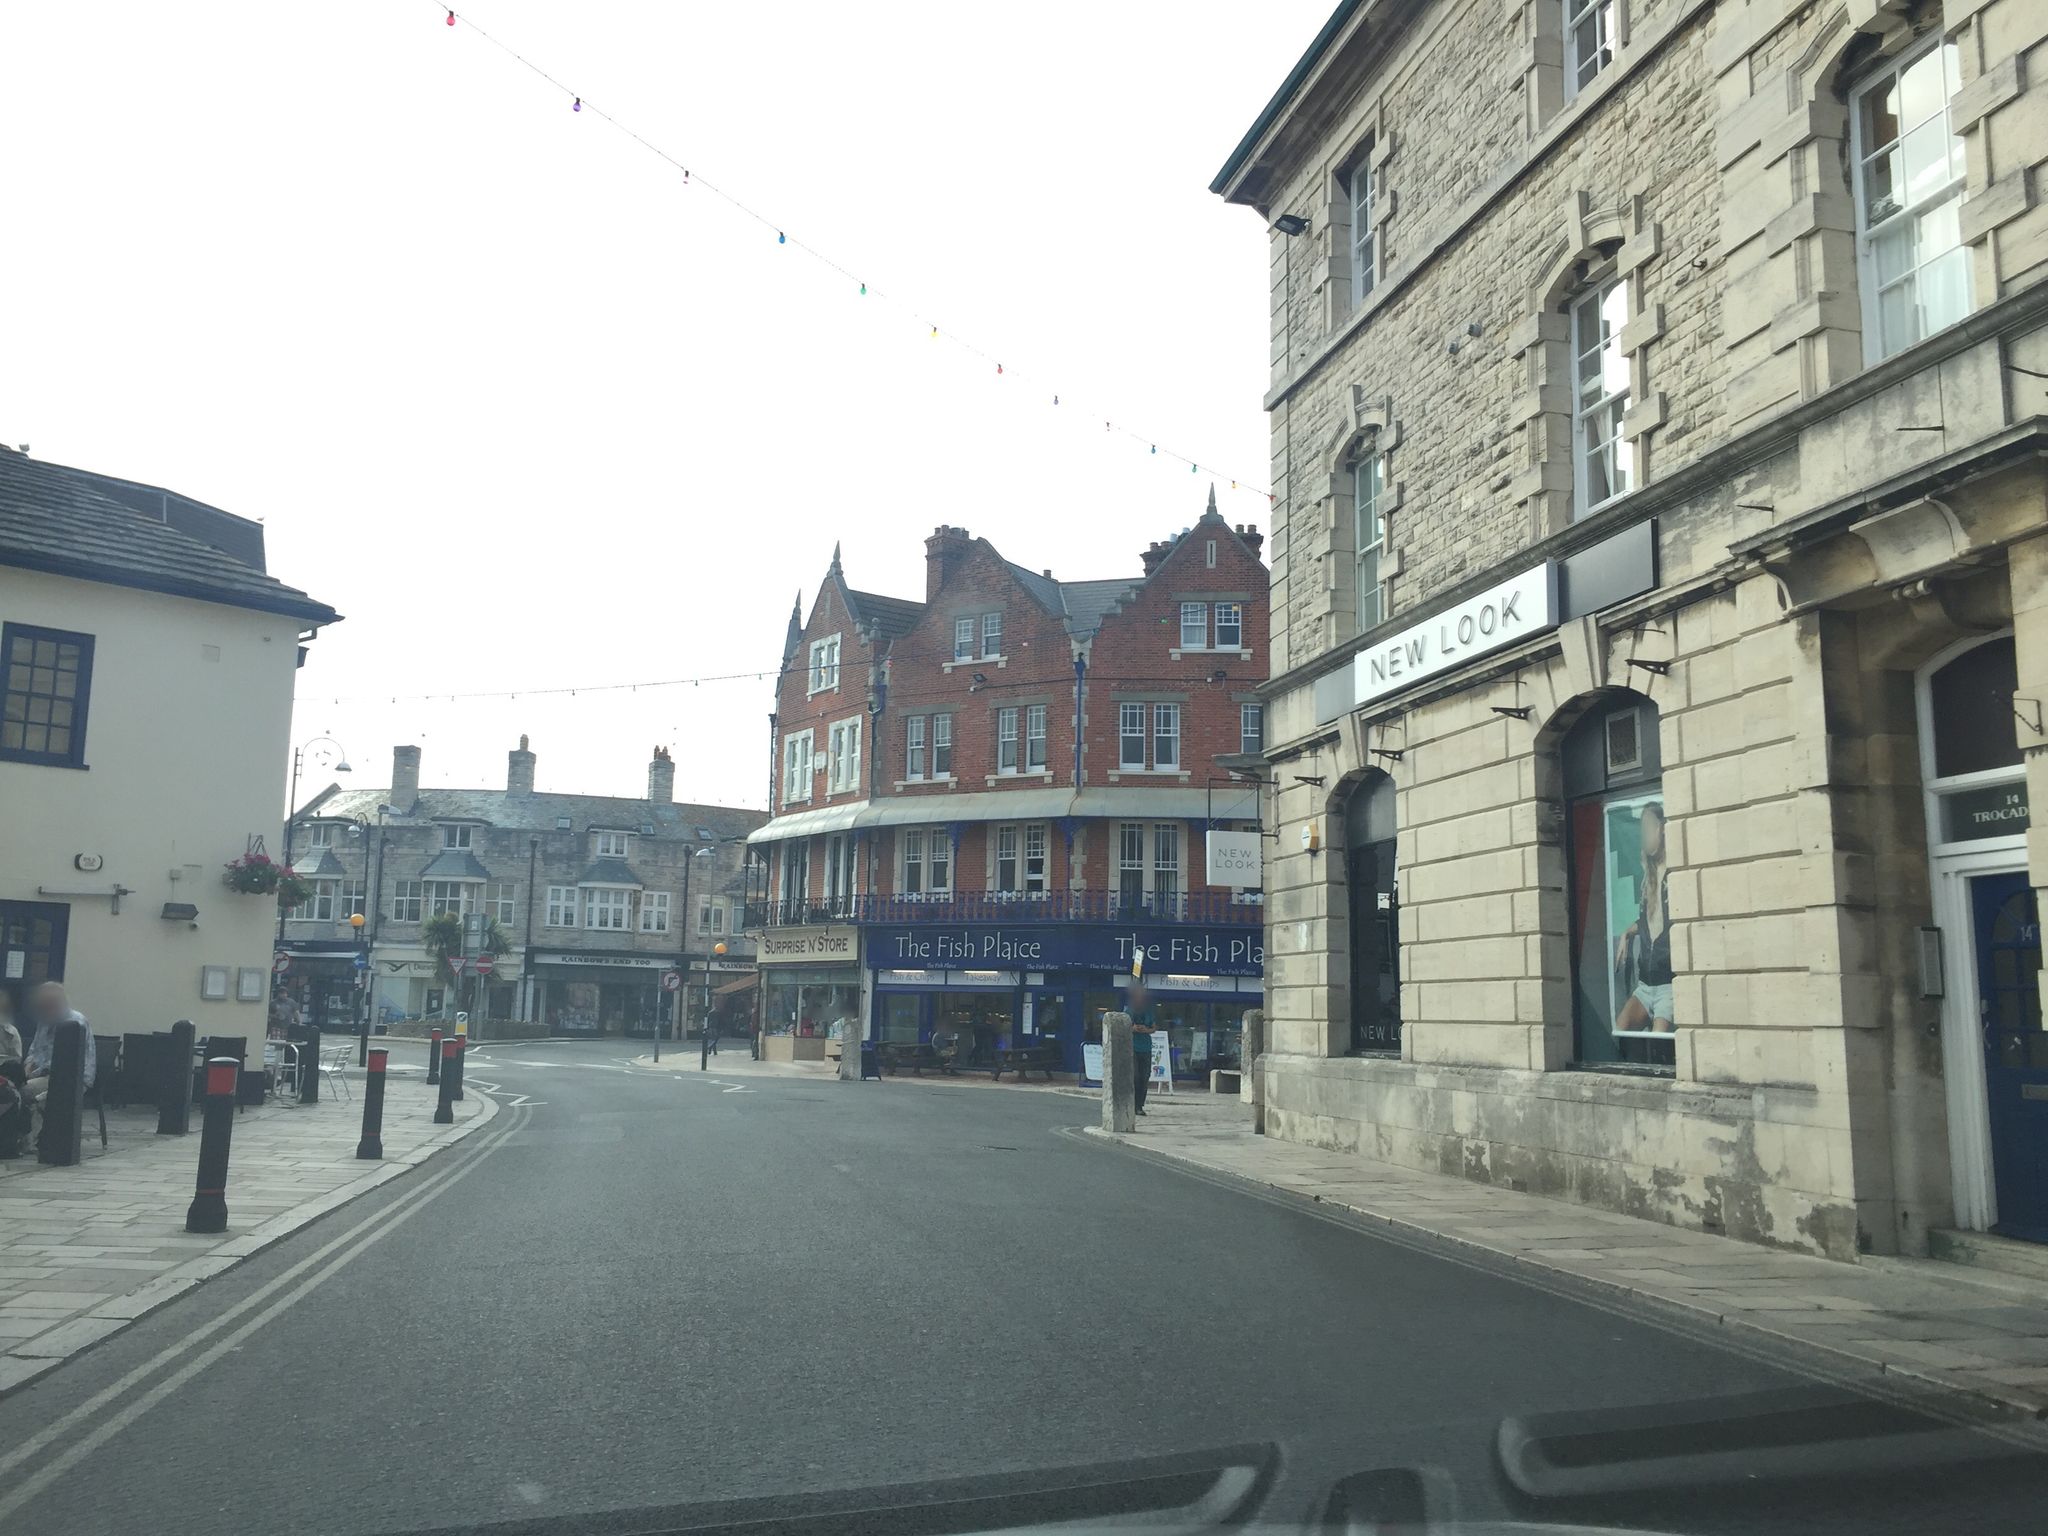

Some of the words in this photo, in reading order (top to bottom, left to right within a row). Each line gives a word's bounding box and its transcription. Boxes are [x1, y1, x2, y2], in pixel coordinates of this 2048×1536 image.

[1370, 635, 1426, 685] NEW
[1441, 590, 1521, 655] LOOK
[2006, 794, 2019, 805] 14
[1218, 849, 1251, 858] NEW
[1215, 860, 1255, 869] LOOK
[765, 939, 806, 955] SURPRISE
[818, 935, 848, 952] STORE
[895, 932, 930, 958] The
[937, 932, 975, 958] Fish
[983, 932, 1041, 960] Plaice
[1114, 933, 1160, 961] The
[1171, 935, 1218, 963] Fish
[1361, 1025, 1385, 1040] NEW
